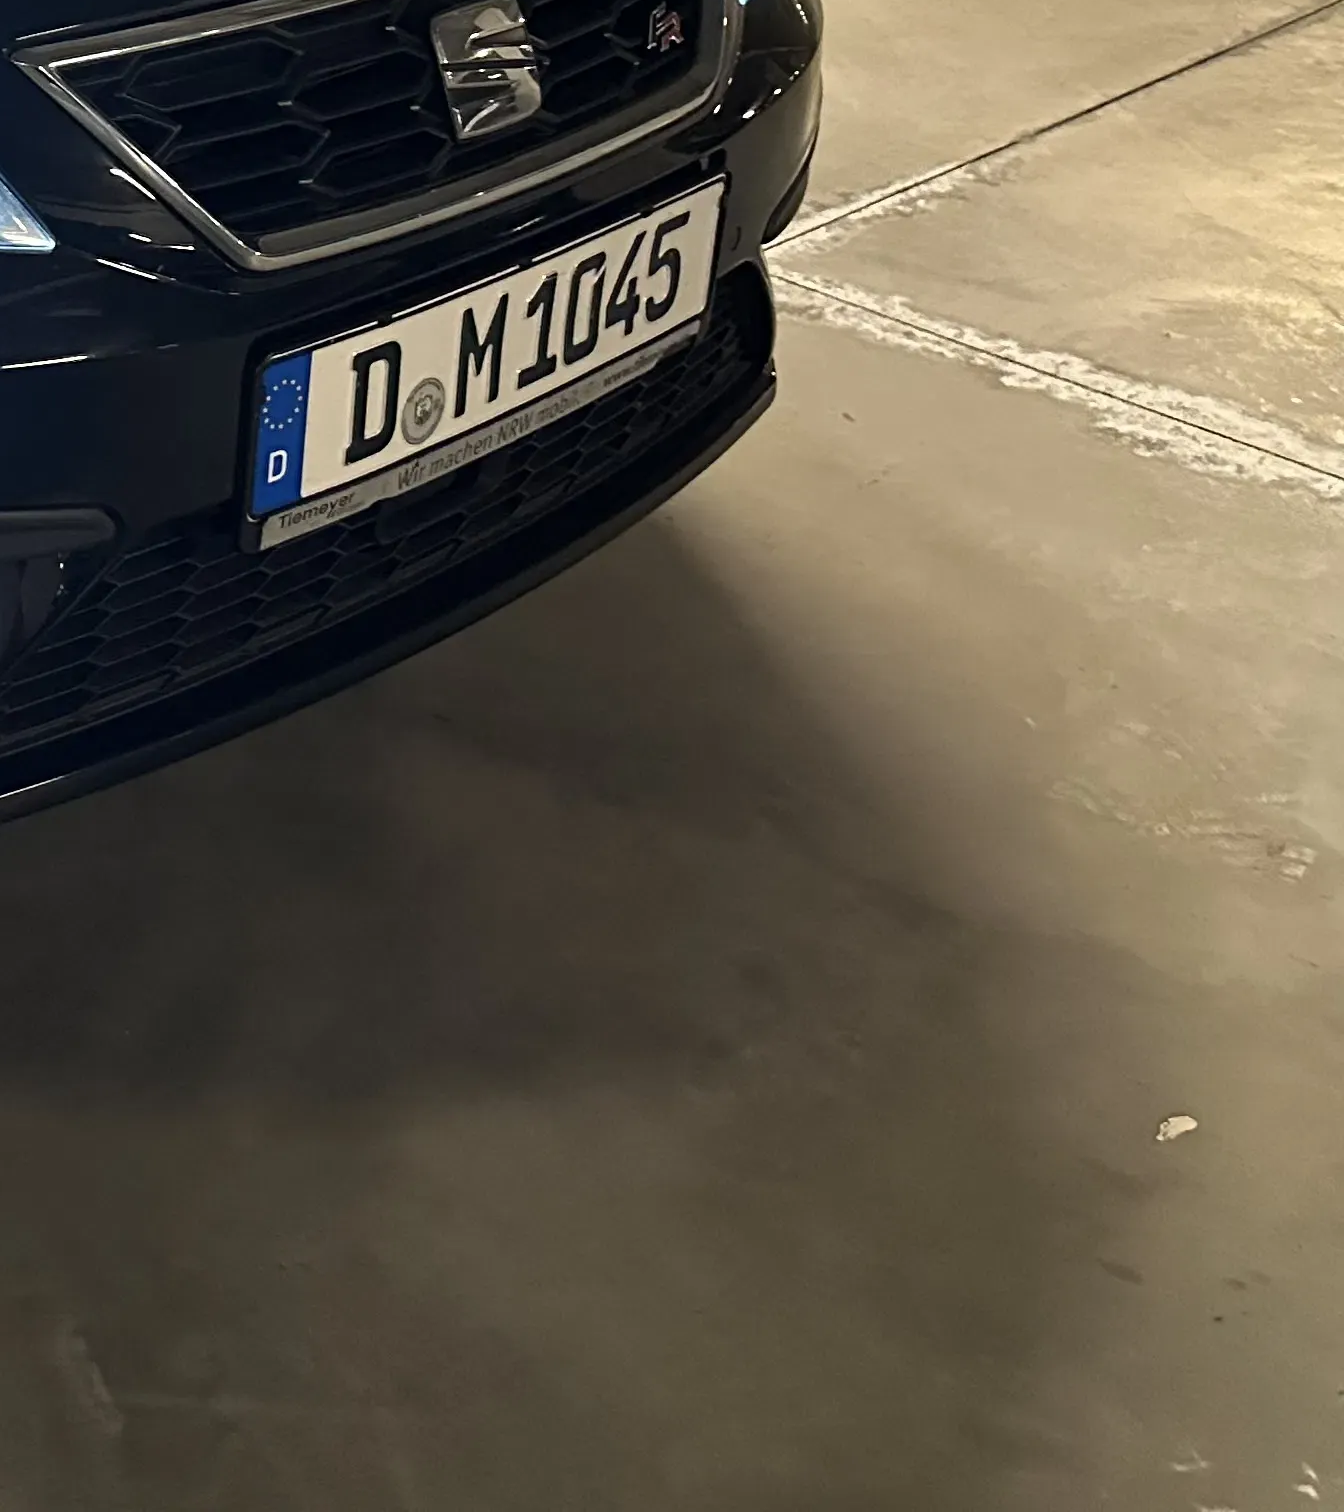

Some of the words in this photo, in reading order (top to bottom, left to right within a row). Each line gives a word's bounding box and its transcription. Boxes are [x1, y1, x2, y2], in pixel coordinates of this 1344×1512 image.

[344, 339, 402, 466] D
[266, 449, 288, 484] D
[429, 436, 493, 476] machen
[494, 412, 535, 445] NRW
[278, 491, 356, 530] Tiemeyer
